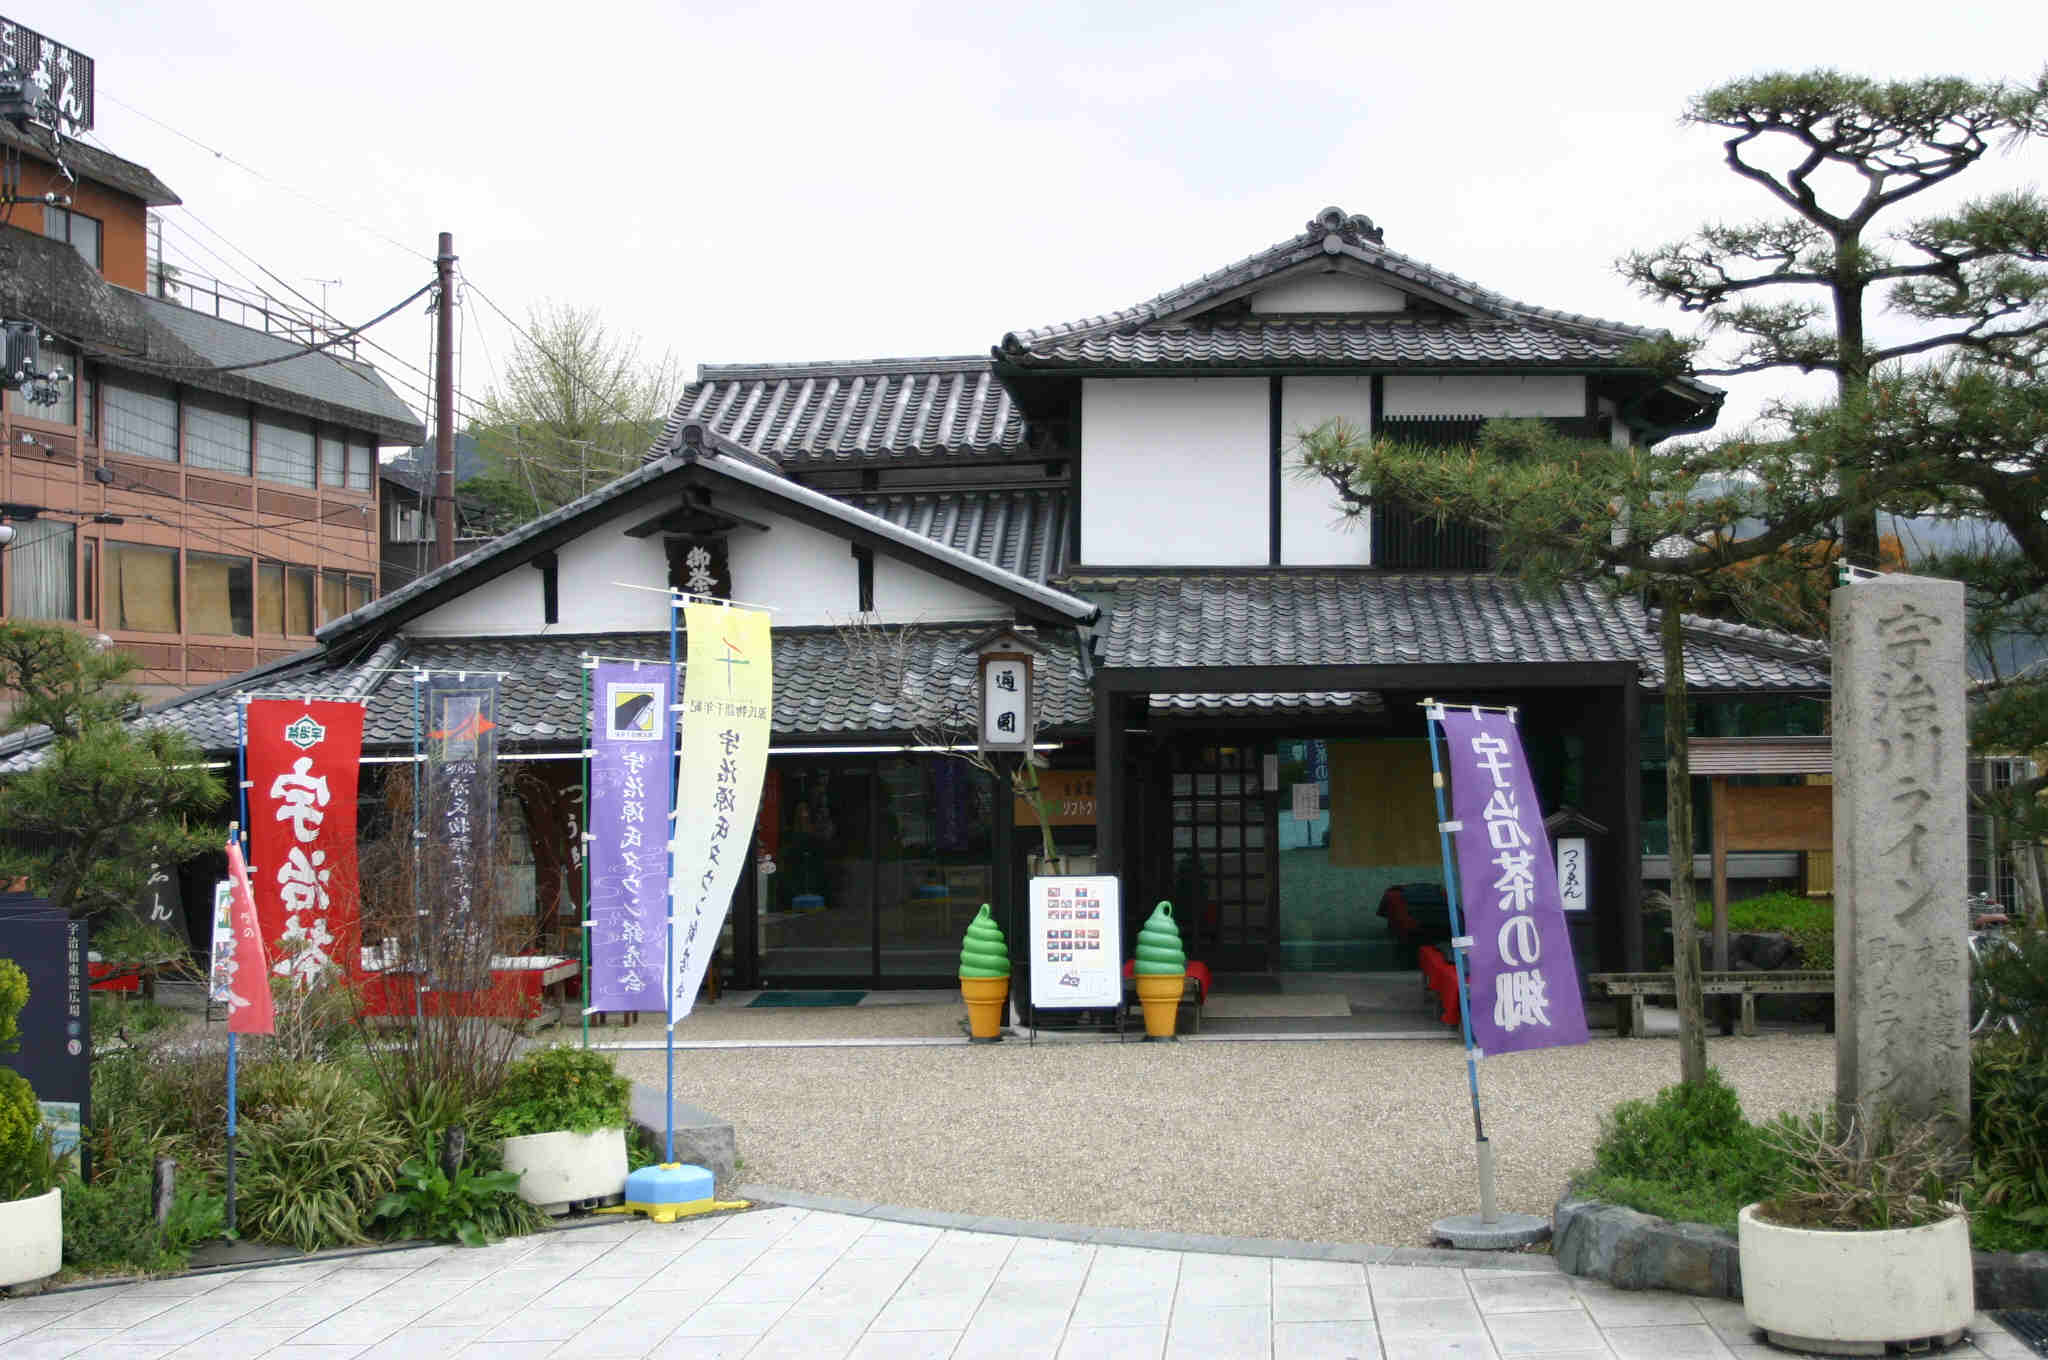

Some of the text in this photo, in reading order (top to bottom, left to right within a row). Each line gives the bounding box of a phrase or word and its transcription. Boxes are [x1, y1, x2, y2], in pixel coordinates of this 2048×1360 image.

[1874, 603, 1943, 927] 宇治川ライン
